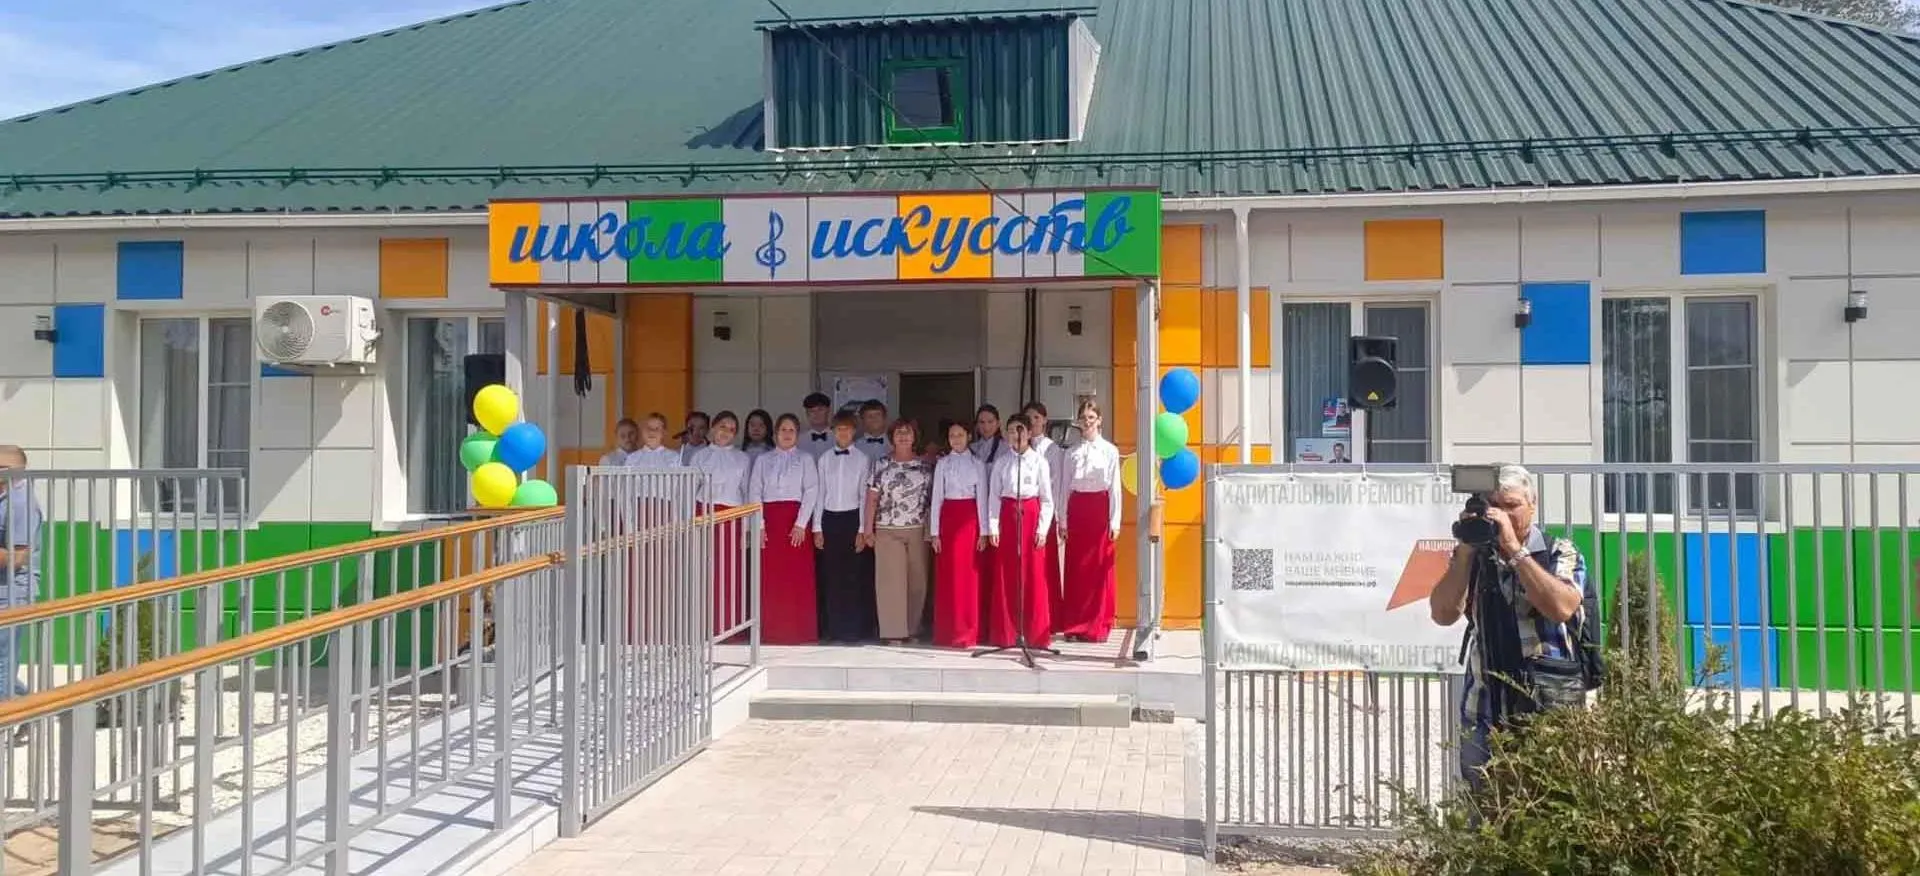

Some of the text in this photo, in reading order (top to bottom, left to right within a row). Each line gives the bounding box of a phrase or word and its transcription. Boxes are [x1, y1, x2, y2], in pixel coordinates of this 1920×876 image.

[508, 196, 1136, 274] школа искусств
[1223, 480, 1352, 504] КАПИТАЛЬНЫЙ
[1359, 483, 1427, 504] РЕМОНТ
[1223, 640, 1354, 664] КАПИТАЛЬНЫЙ
[1360, 645, 1431, 666] РЕМОНТ
